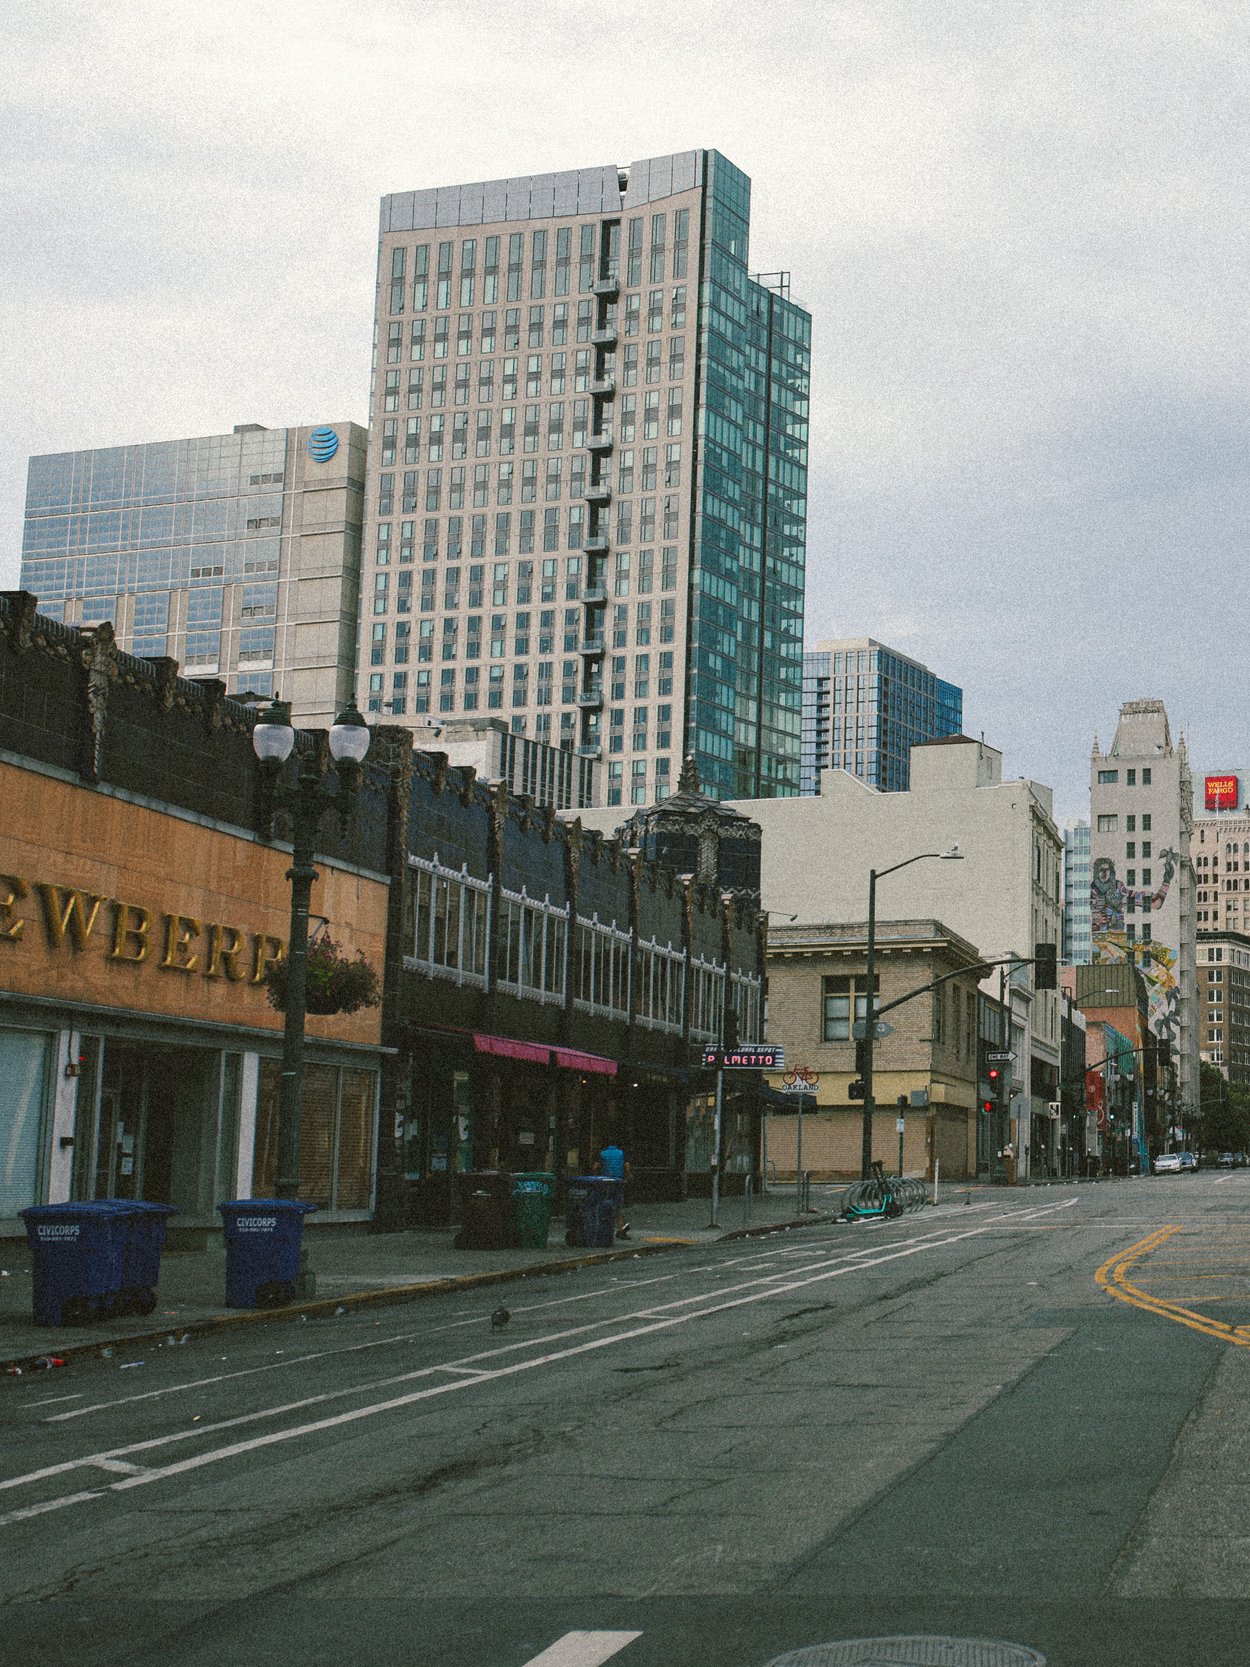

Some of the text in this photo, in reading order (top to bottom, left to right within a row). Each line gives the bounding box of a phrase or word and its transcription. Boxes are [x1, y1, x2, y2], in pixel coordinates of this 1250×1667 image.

[707, 1056, 773, 1065] PLMETTO
[237, 1217, 277, 1227] CIVICORPS
[38, 1225, 80, 1236] CIVICORPS
